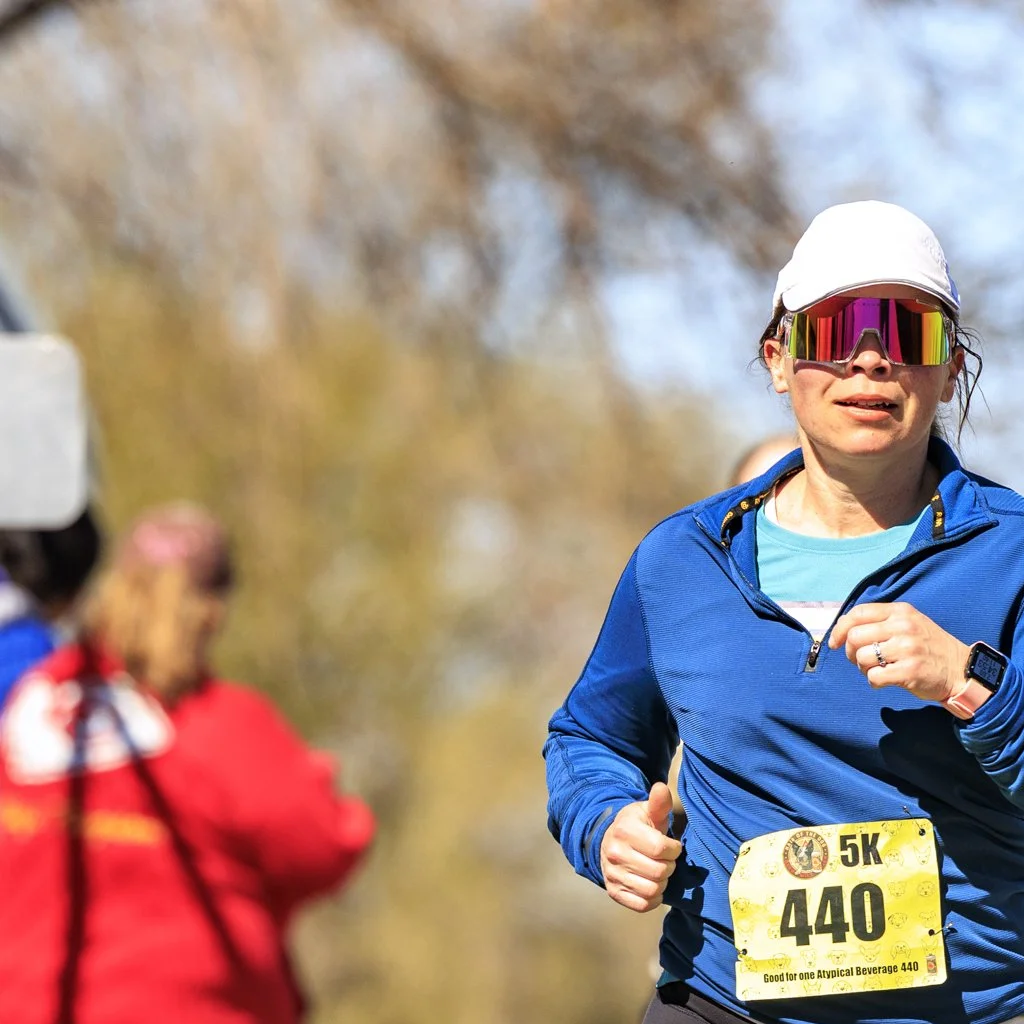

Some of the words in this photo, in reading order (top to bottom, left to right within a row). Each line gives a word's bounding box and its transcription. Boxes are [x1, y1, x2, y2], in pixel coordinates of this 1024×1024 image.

[839, 832, 883, 867] 5K
[780, 882, 886, 947] 440
[763, 972, 785, 983] Good
[785, 971, 797, 981] for
[798, 971, 815, 981] one
[816, 966, 854, 981] Atypical
[855, 964, 898, 976] Beverage
[900, 961, 919, 972] 440
